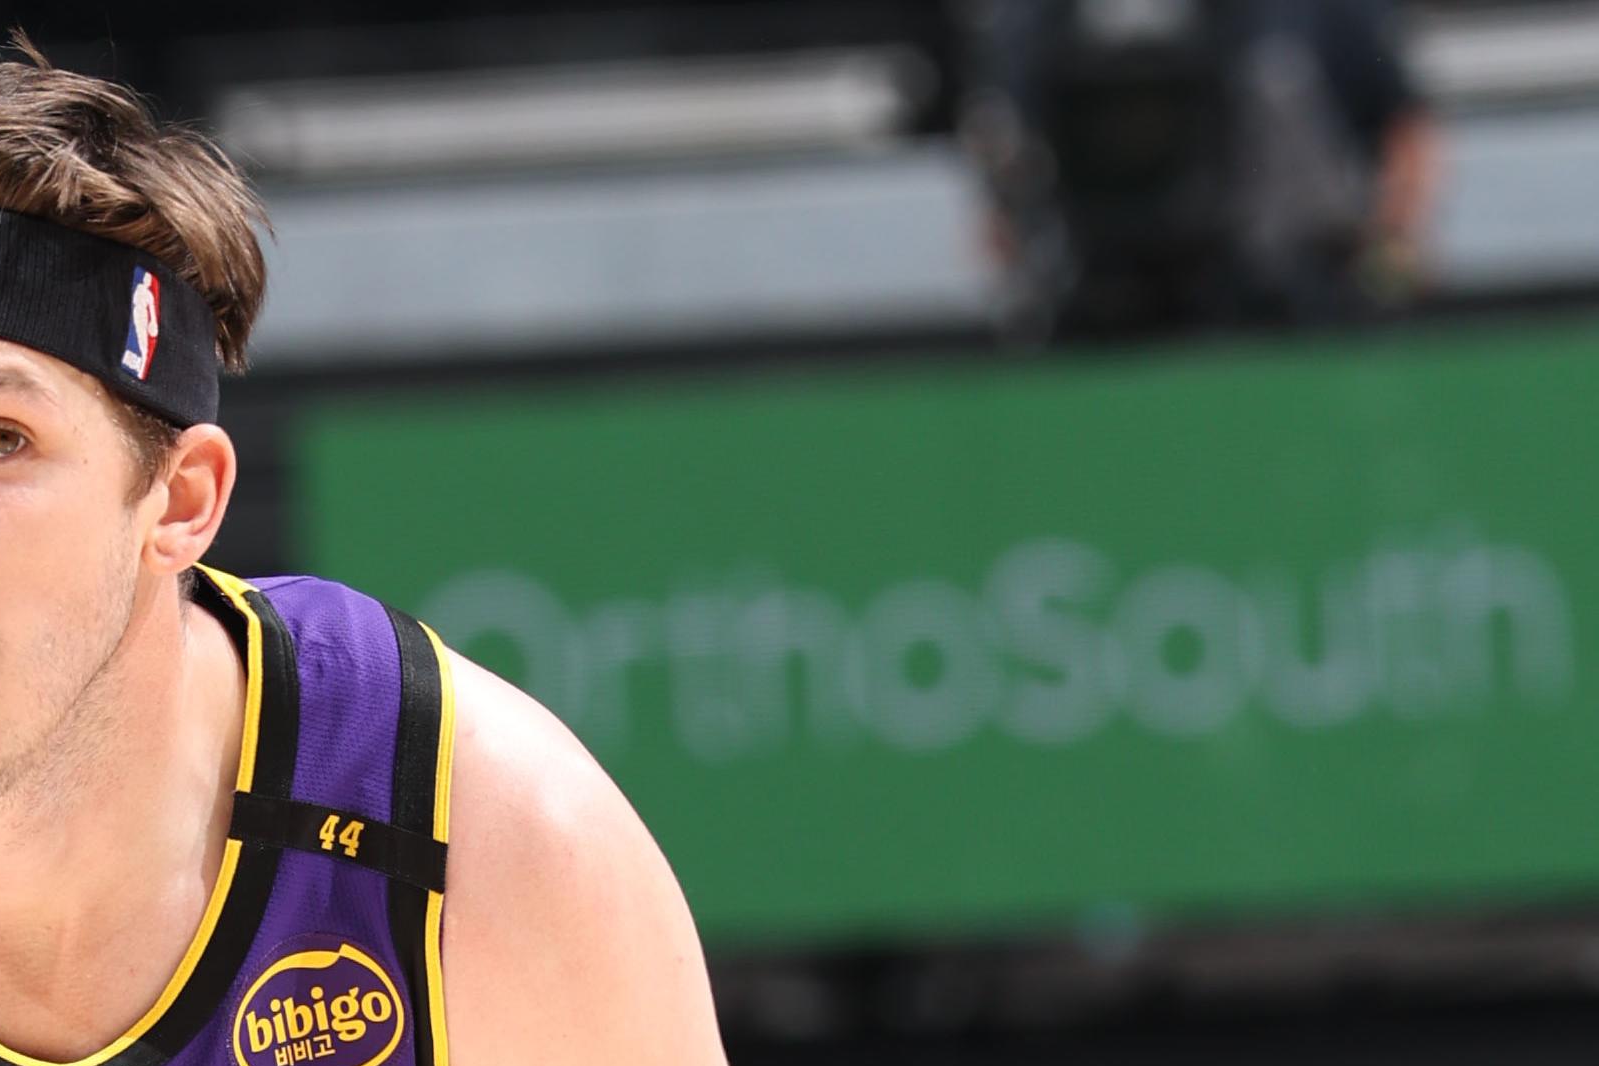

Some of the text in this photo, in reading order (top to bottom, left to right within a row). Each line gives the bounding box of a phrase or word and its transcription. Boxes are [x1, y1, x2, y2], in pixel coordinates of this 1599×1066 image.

[419, 524, 1579, 766] OrthoSouth
[318, 814, 365, 857] 44
[246, 986, 392, 1054] bibigo
